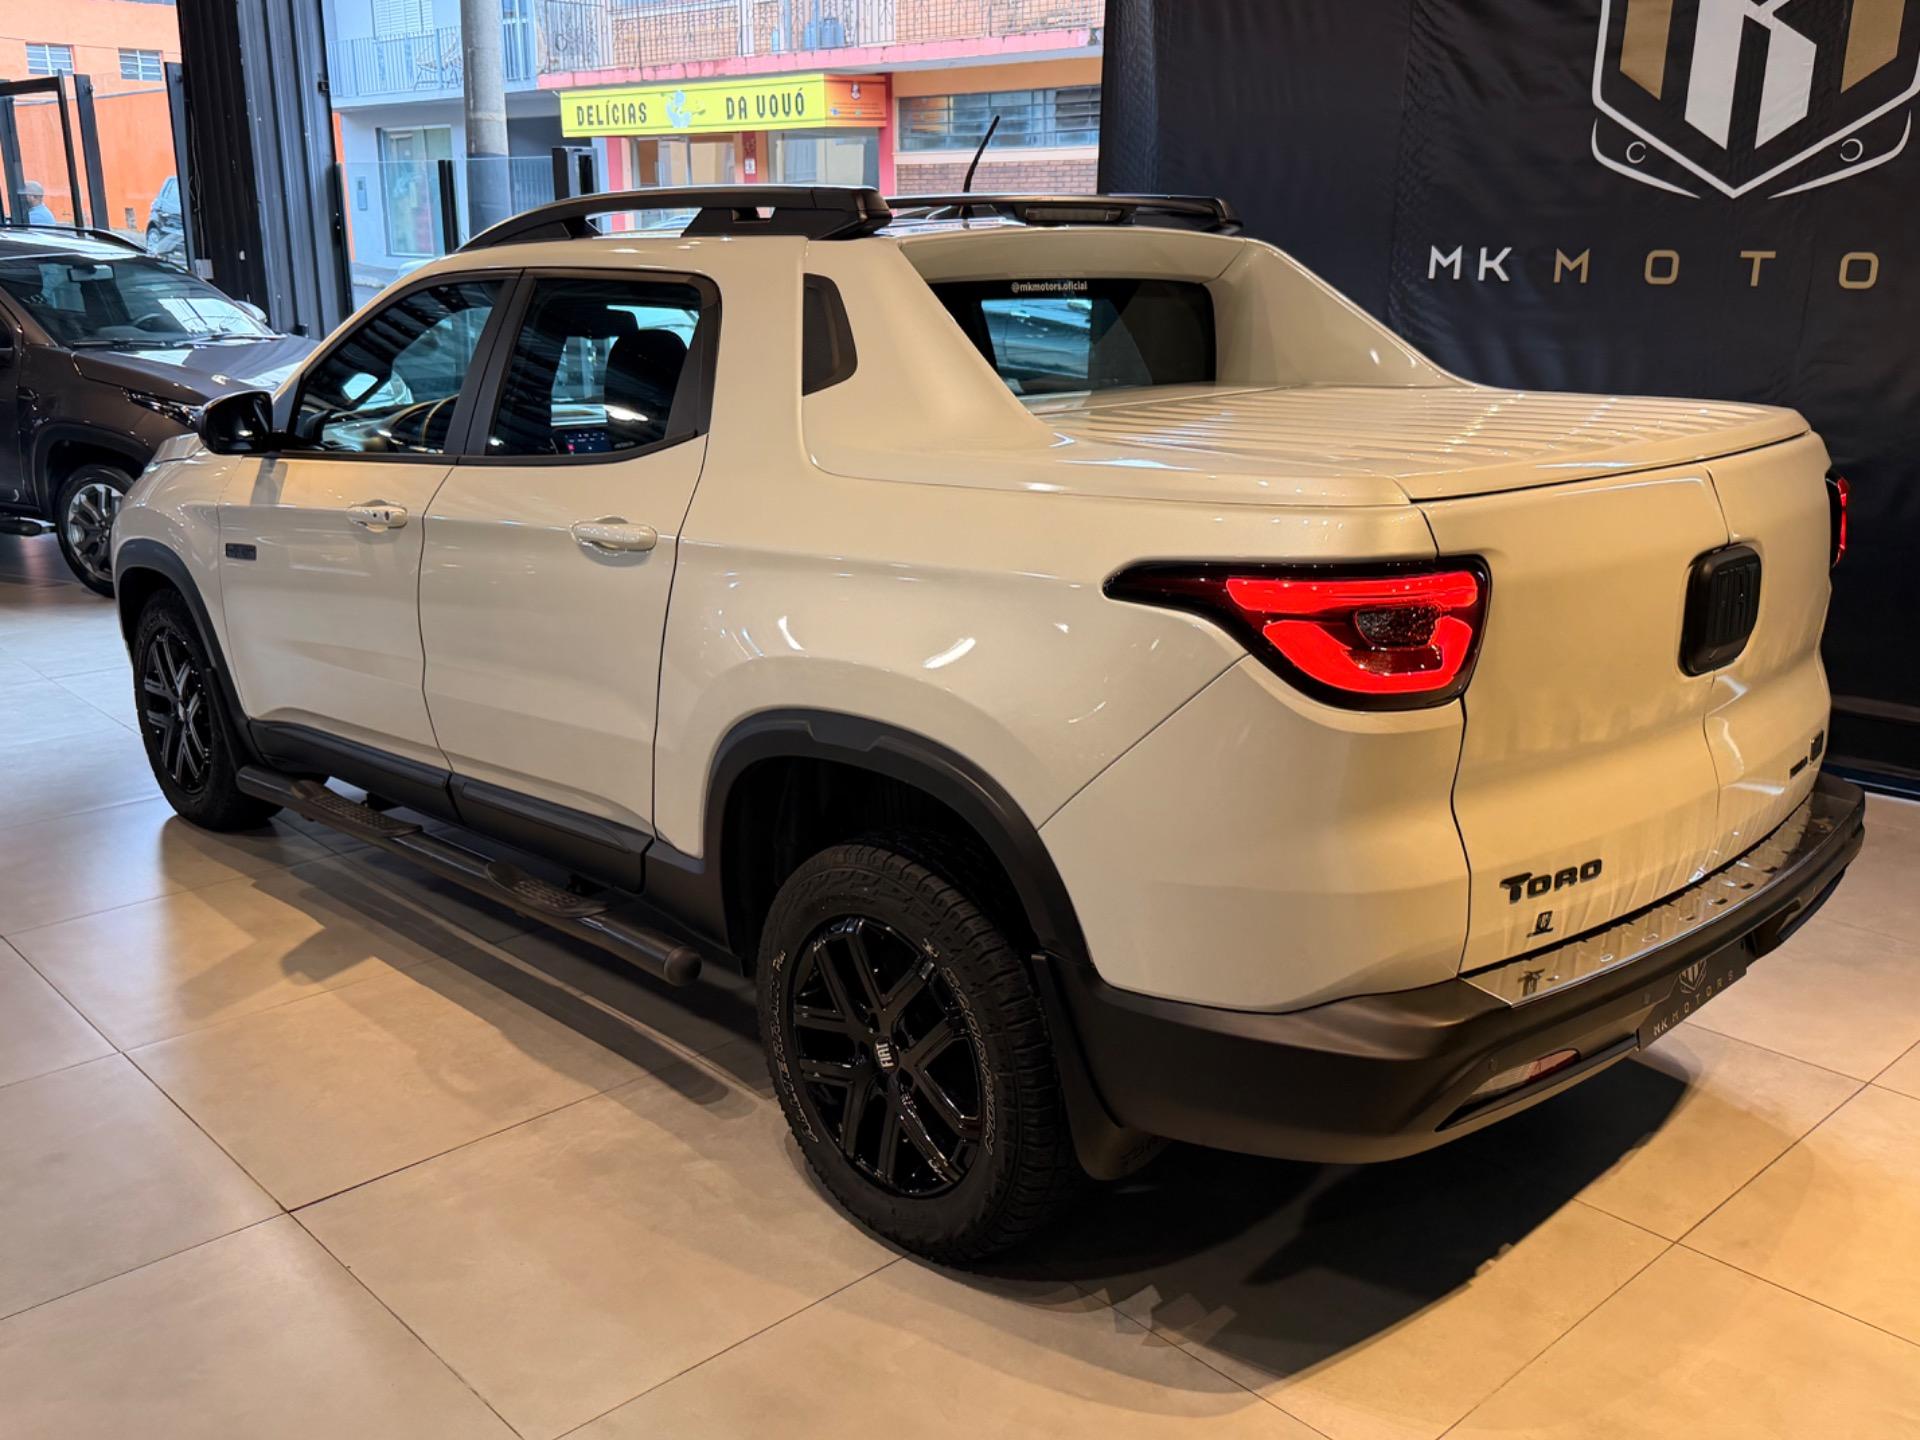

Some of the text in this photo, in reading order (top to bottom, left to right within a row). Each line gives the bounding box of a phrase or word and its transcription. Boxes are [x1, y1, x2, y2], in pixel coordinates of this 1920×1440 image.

[576, 99, 647, 127] DELÍCIAS
[726, 95, 748, 120] DA
[1427, 245, 1512, 282] MK
[875, 1042, 895, 1068] FIAT
